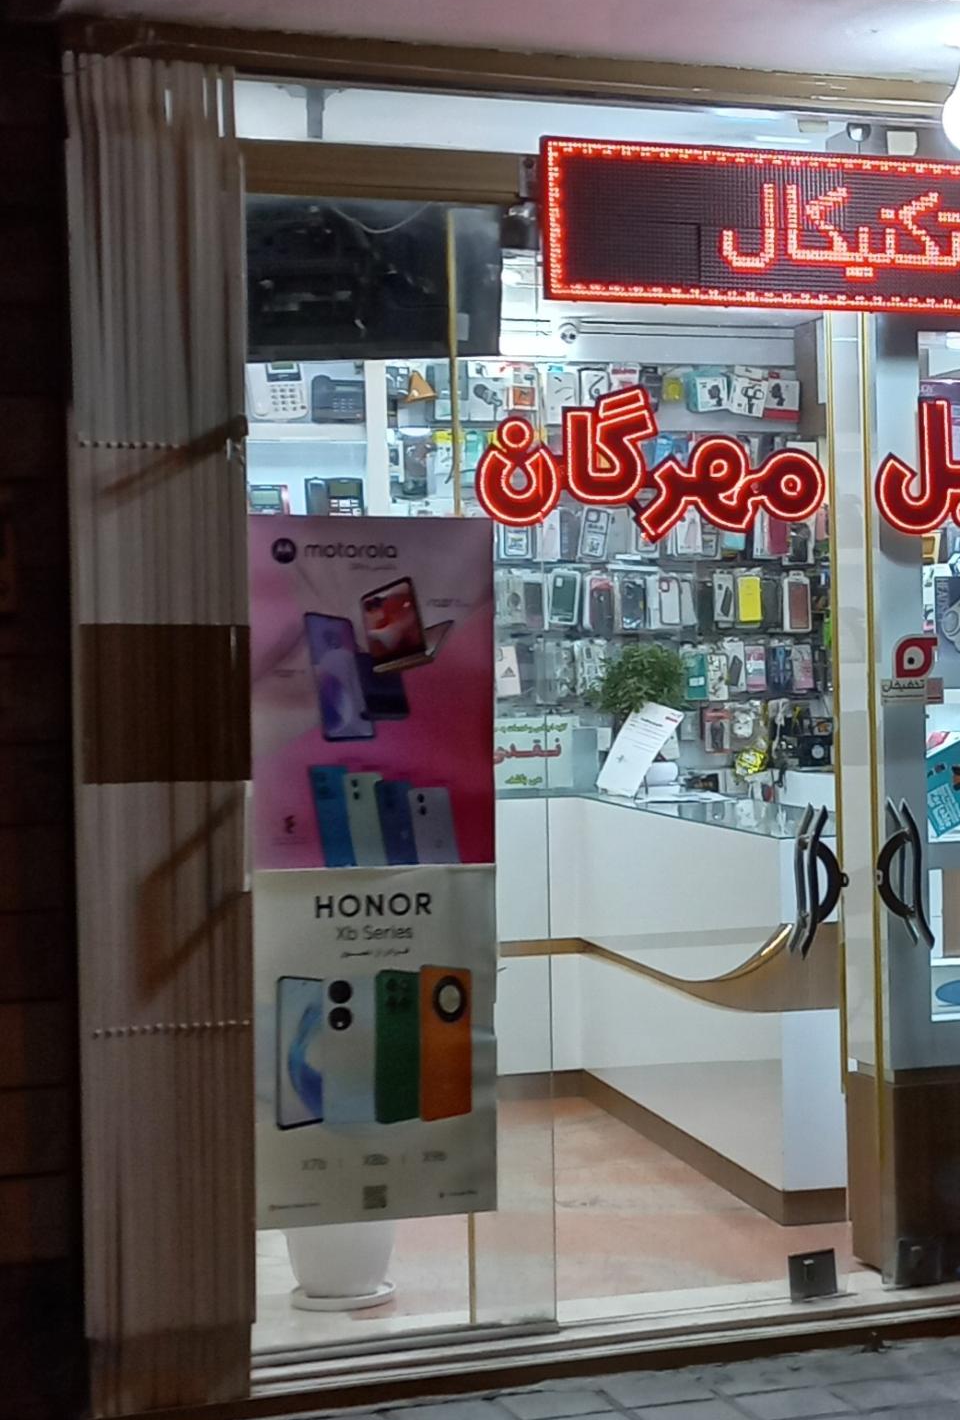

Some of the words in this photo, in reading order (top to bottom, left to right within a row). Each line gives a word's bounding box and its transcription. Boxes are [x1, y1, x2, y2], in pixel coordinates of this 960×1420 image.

[475, 384, 829, 543] مهرگان
[304, 542, 398, 559] motorola
[315, 892, 432, 919] HONOR
[362, 924, 413, 941] Series
